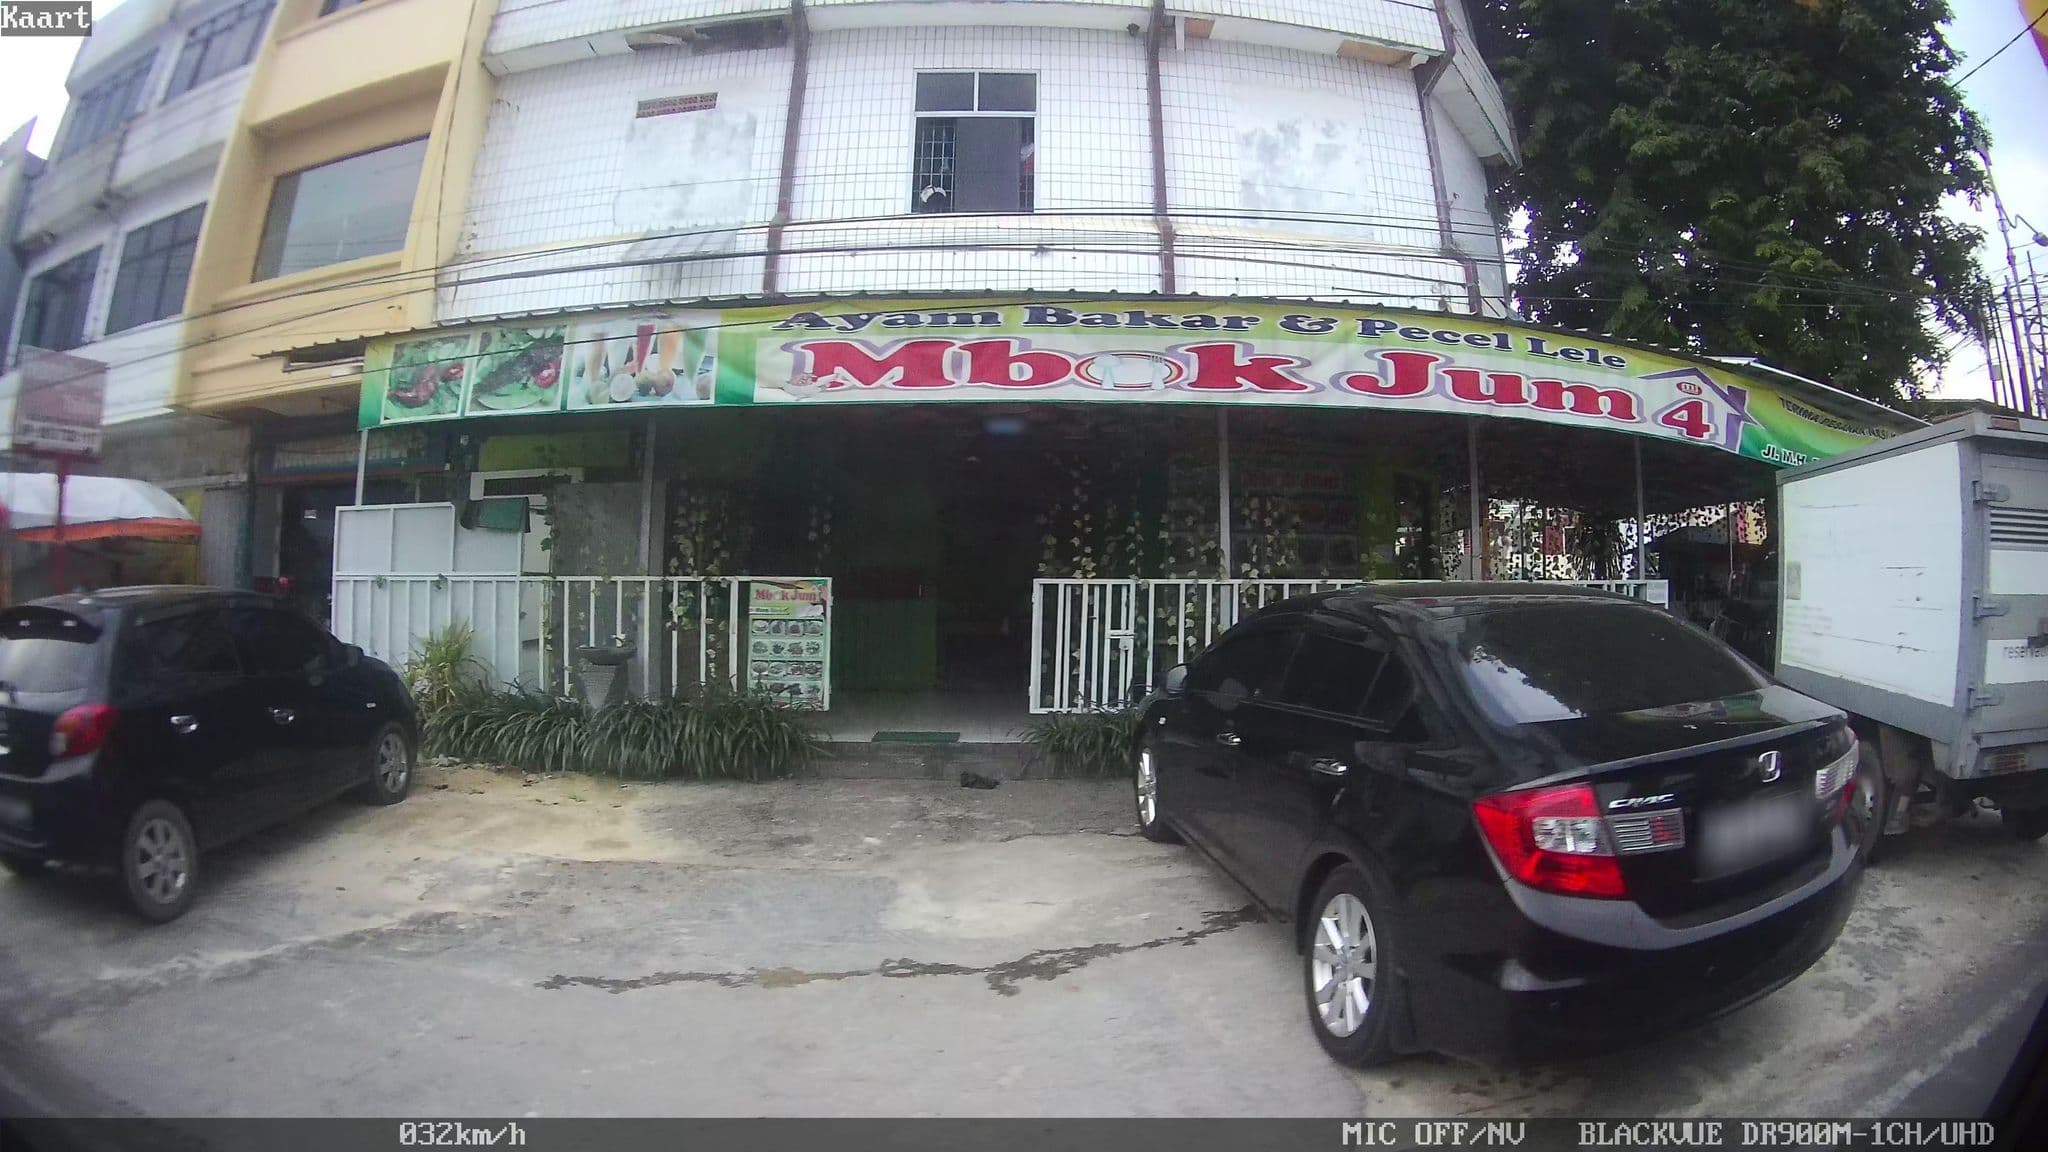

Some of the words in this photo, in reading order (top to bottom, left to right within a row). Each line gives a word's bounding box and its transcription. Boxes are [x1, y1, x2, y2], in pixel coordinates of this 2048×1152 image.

[771, 309, 1002, 333] Ayam
[1023, 305, 1261, 332] Bakar
[1279, 314, 1340, 334] &
[1355, 317, 1514, 352] Pecel
[1526, 336, 1627, 369] Lele
[1340, 349, 1640, 422] Jum
[1659, 398, 1716, 440] 4
